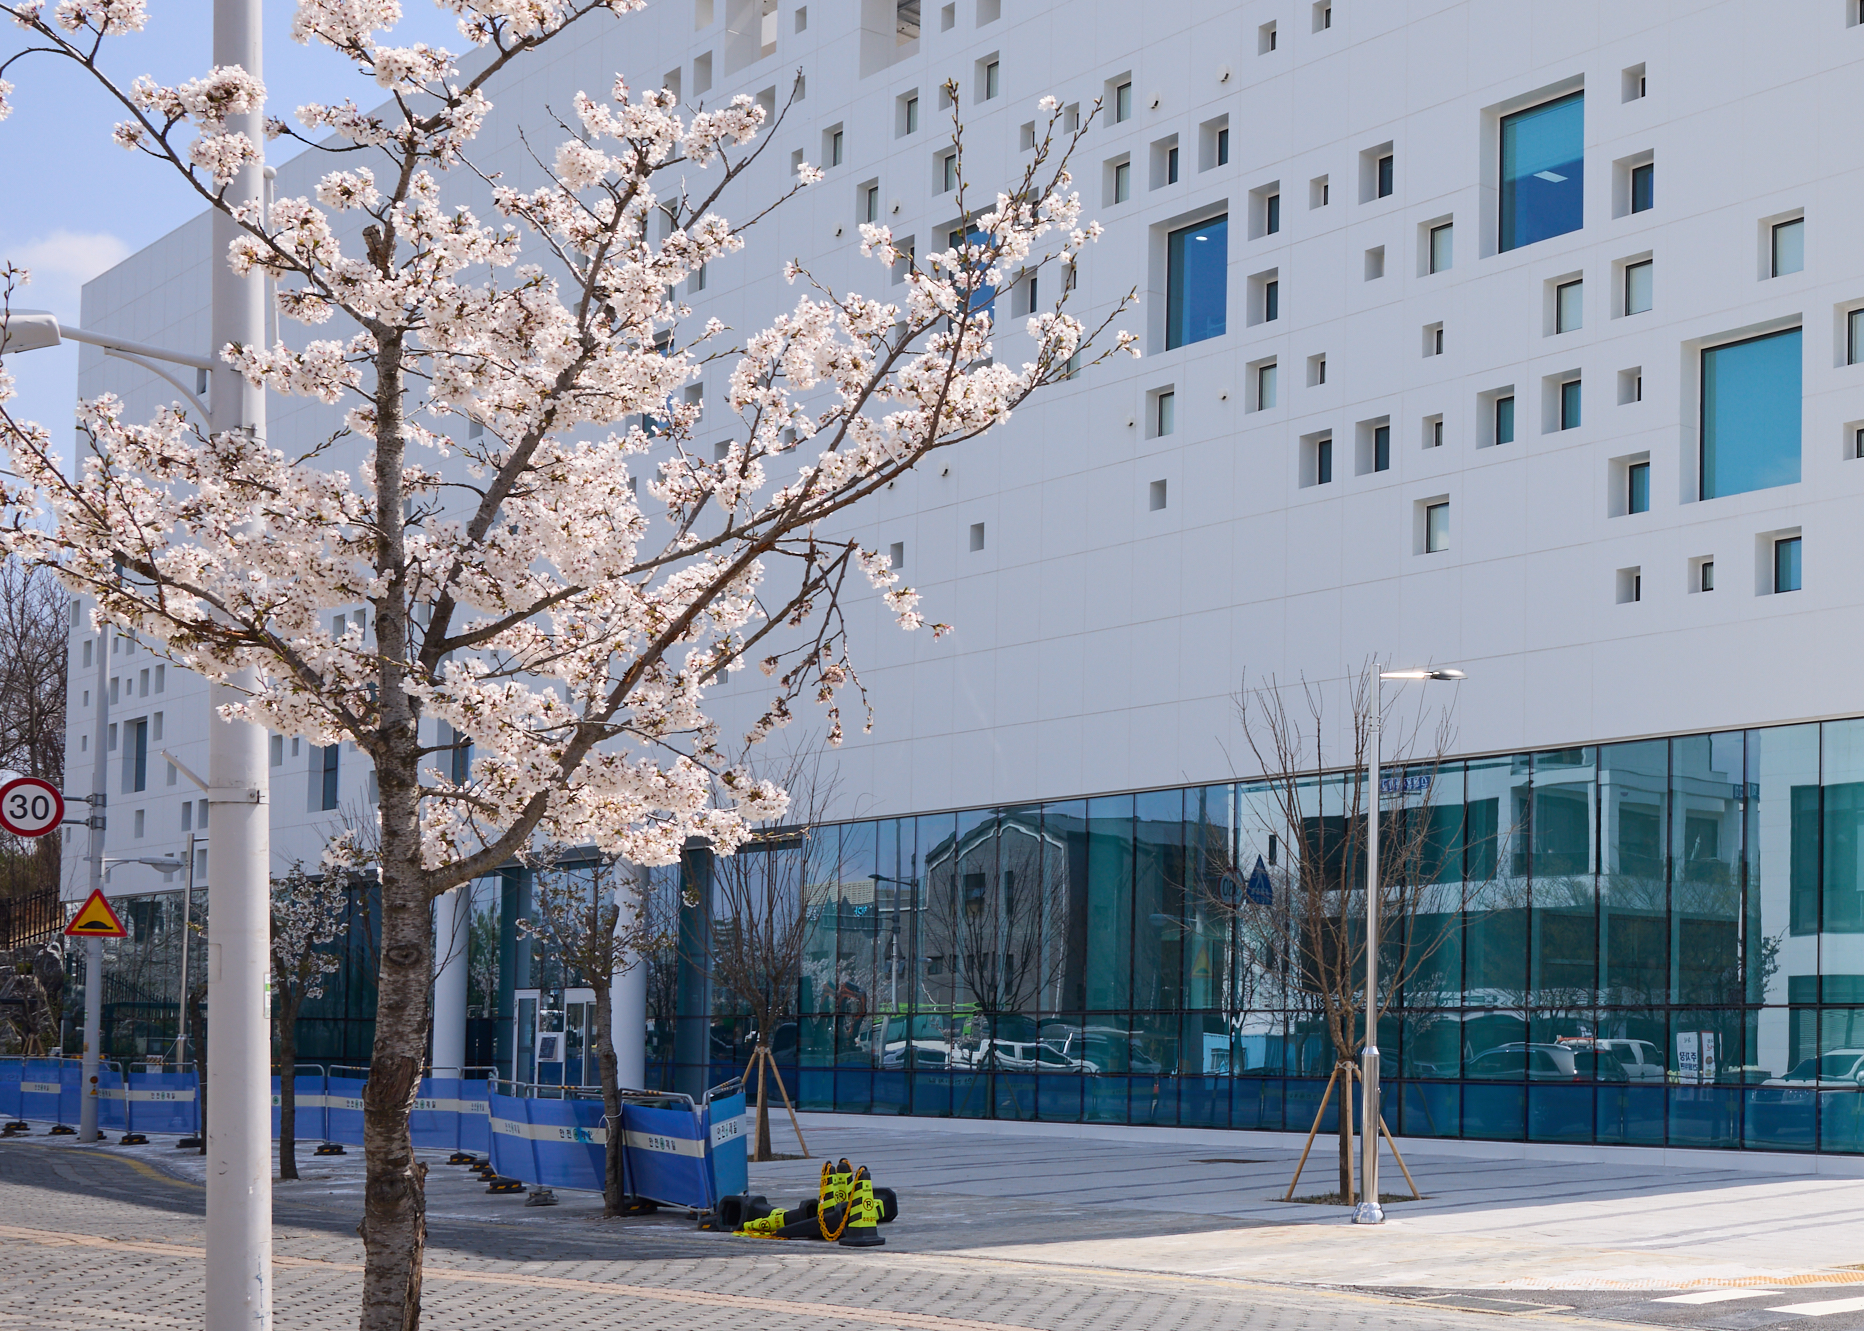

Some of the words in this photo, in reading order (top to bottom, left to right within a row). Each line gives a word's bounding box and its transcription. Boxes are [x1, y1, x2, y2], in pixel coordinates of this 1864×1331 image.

[9, 794, 50, 821] 30
[559, 1128, 572, 1139] 안전
[716, 1125, 726, 1140] 안전
[648, 1137, 659, 1148] 안전
